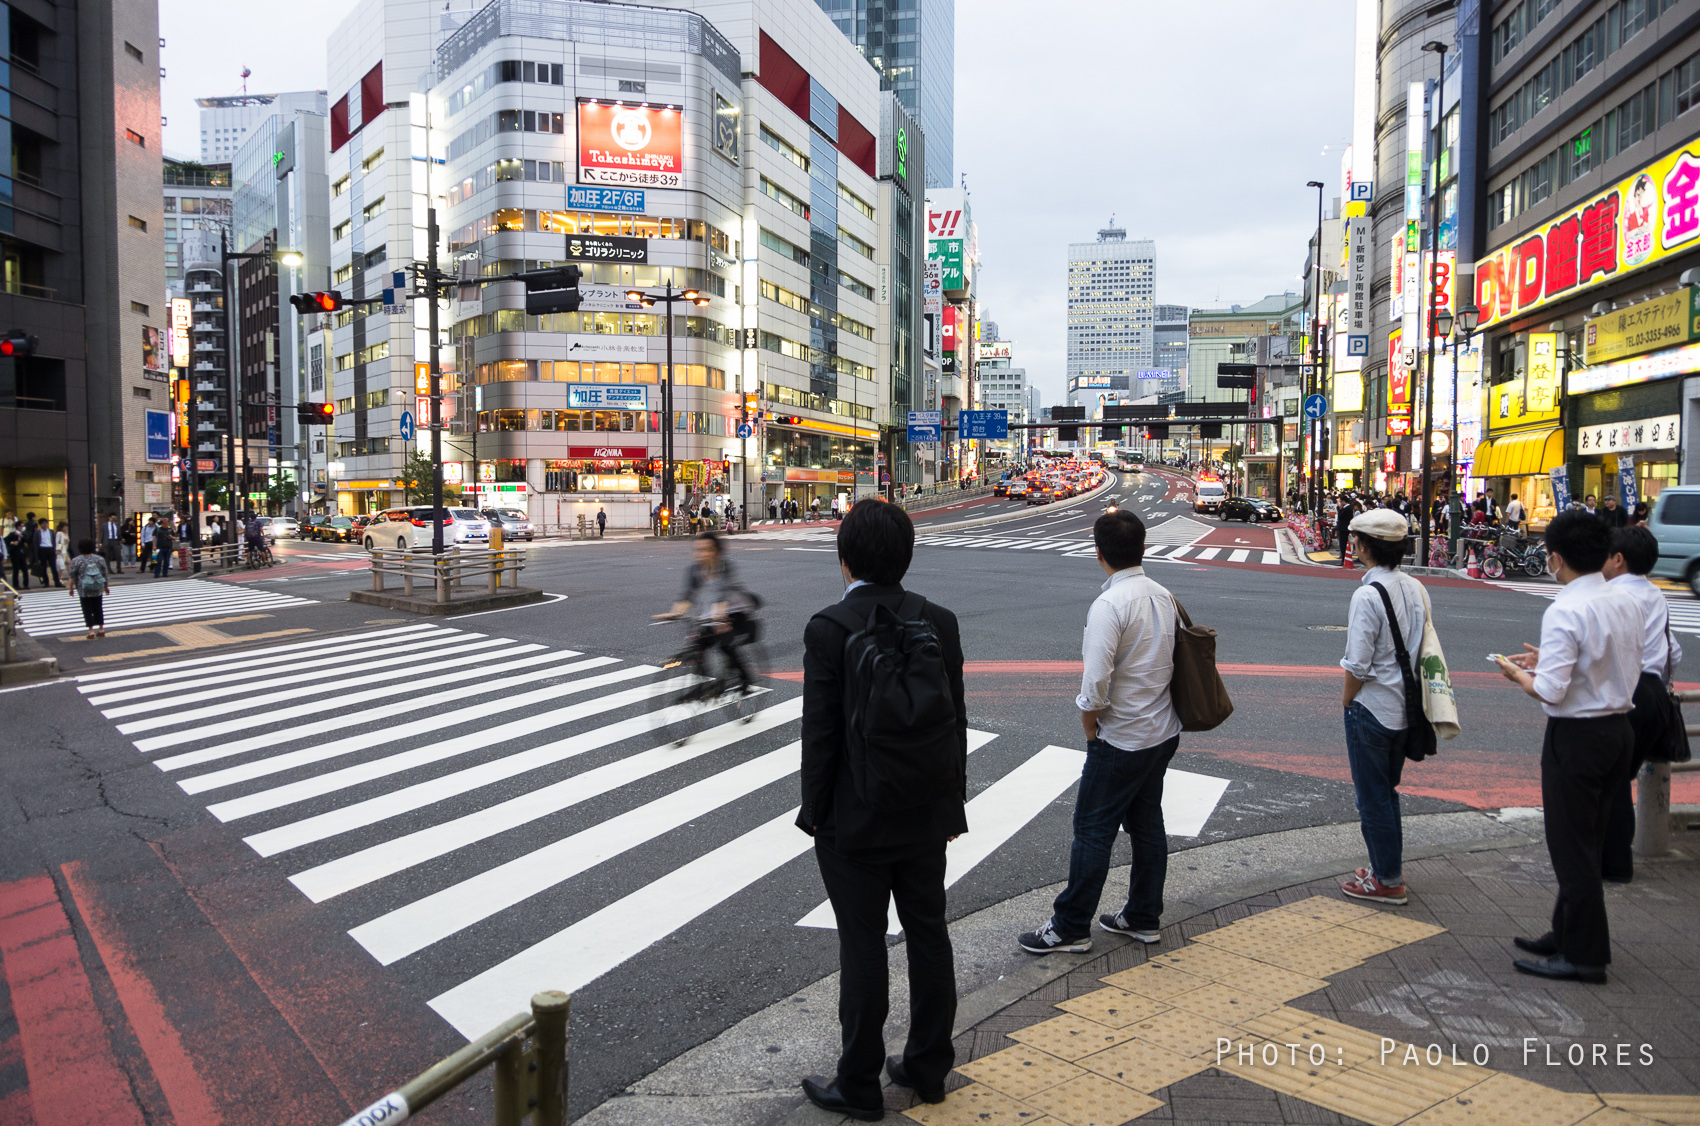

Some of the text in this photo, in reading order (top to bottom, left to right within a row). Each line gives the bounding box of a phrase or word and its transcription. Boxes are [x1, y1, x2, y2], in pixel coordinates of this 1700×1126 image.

[589, 150, 675, 170] Takashimaya
[600, 170, 679, 186] ここから徒歩3分
[570, 188, 643, 206] 加圧 2F/6F
[1357, 184, 1368, 198] P
[1665, 160, 1700, 242] 金
[585, 246, 645, 259] ゴリラクリニック
[1476, 191, 1620, 324] DVD鑑賞
[383, 304, 407, 315] 時差式
[1588, 333, 1597, 344] 2F
[1625, 323, 1681, 348] TEL.03-3355-4966
[1353, 339, 1363, 352] P
[1088, 376, 1111, 384] LABI
[573, 389, 603, 404] 加圧
[972, 412, 992, 420] 八王子
[1582, 422, 1676, 449] おそば 増田屋
[594, 448, 623, 458] HONMA
